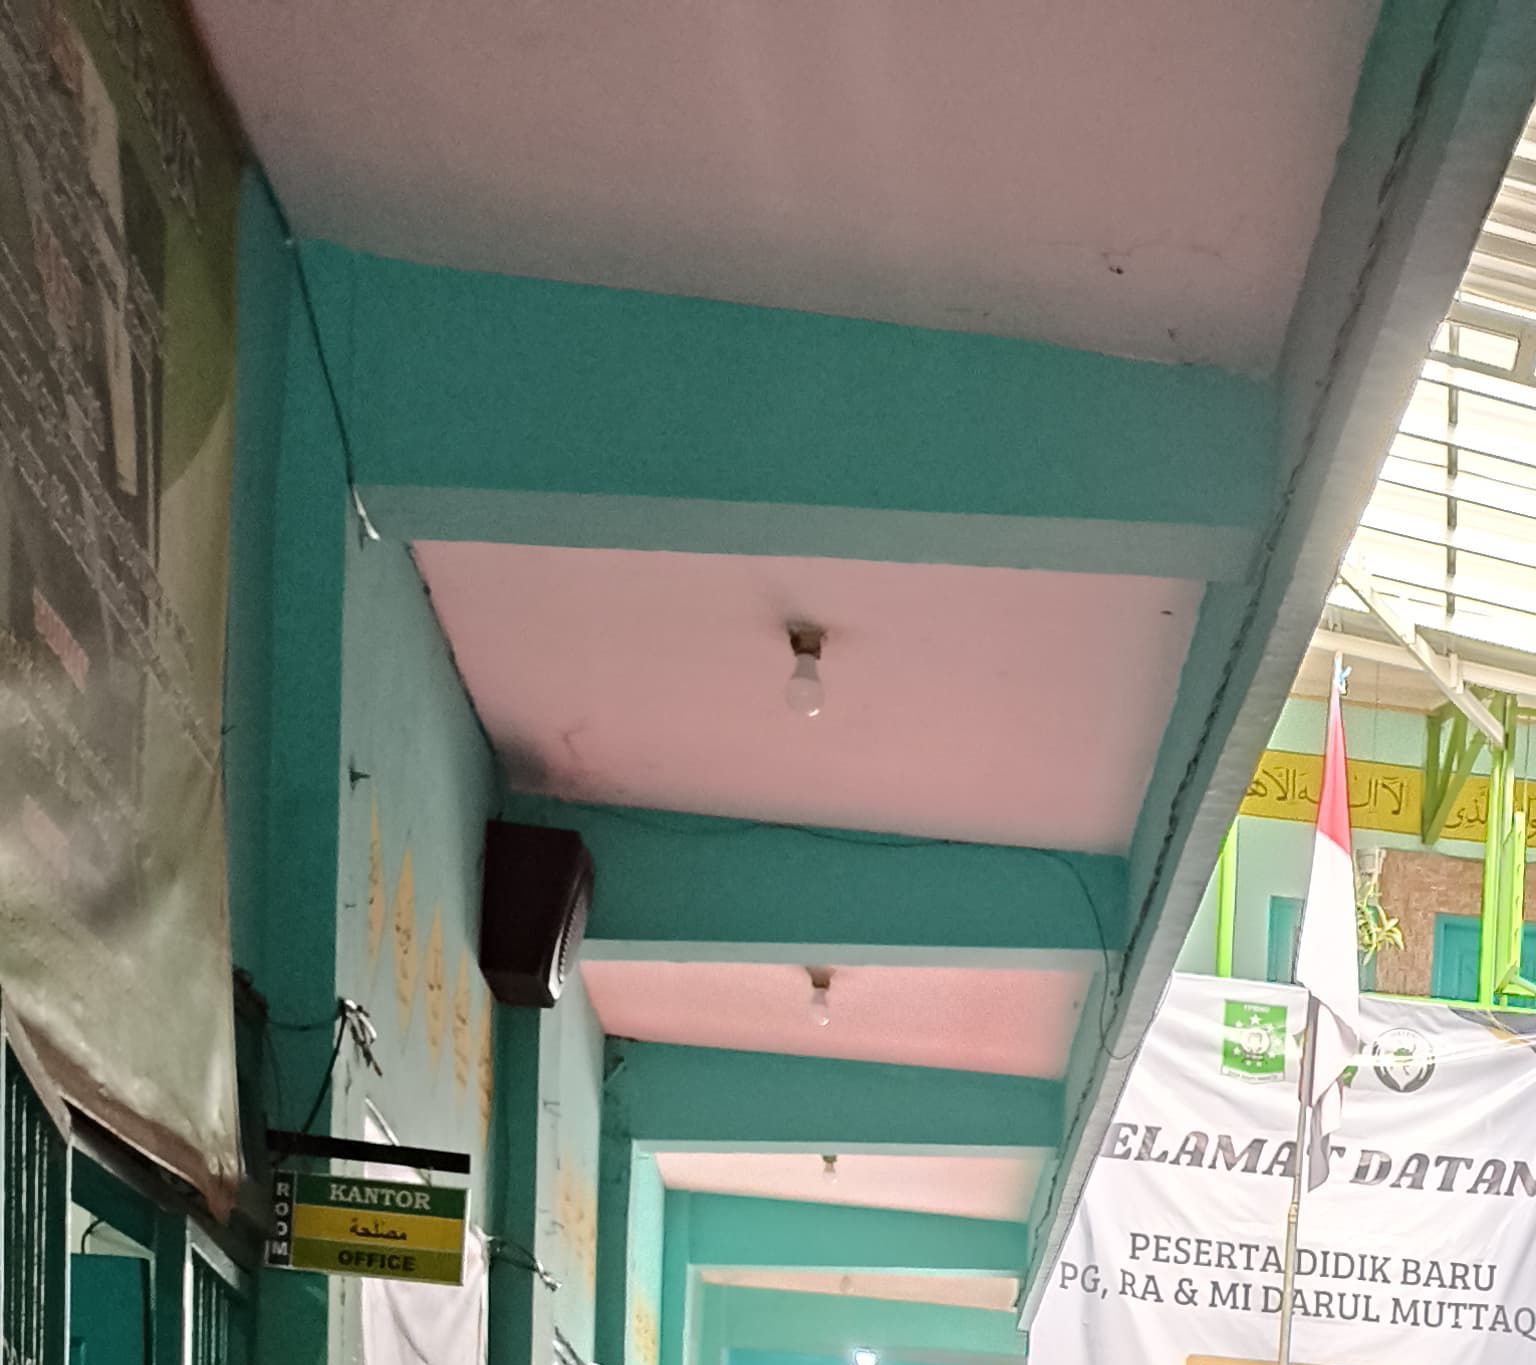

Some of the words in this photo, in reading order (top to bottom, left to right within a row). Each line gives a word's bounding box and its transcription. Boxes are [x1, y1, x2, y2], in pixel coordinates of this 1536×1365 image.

[1101, 1122, 1346, 1179] ELAMA
[330, 1183, 431, 1211] KANTOR
[338, 1250, 416, 1272] OFFICE
[1129, 1232, 1286, 1274] PESERTA
[1294, 1248, 1391, 1285] DIDIK
[1400, 1258, 1497, 1292] BARU
[1059, 1261, 1109, 1299] PG,
[1118, 1268, 1165, 1303] RA
[1174, 1277, 1198, 1306] &
[1208, 1280, 1253, 1311] MI
[1261, 1284, 1380, 1323] DARUL
